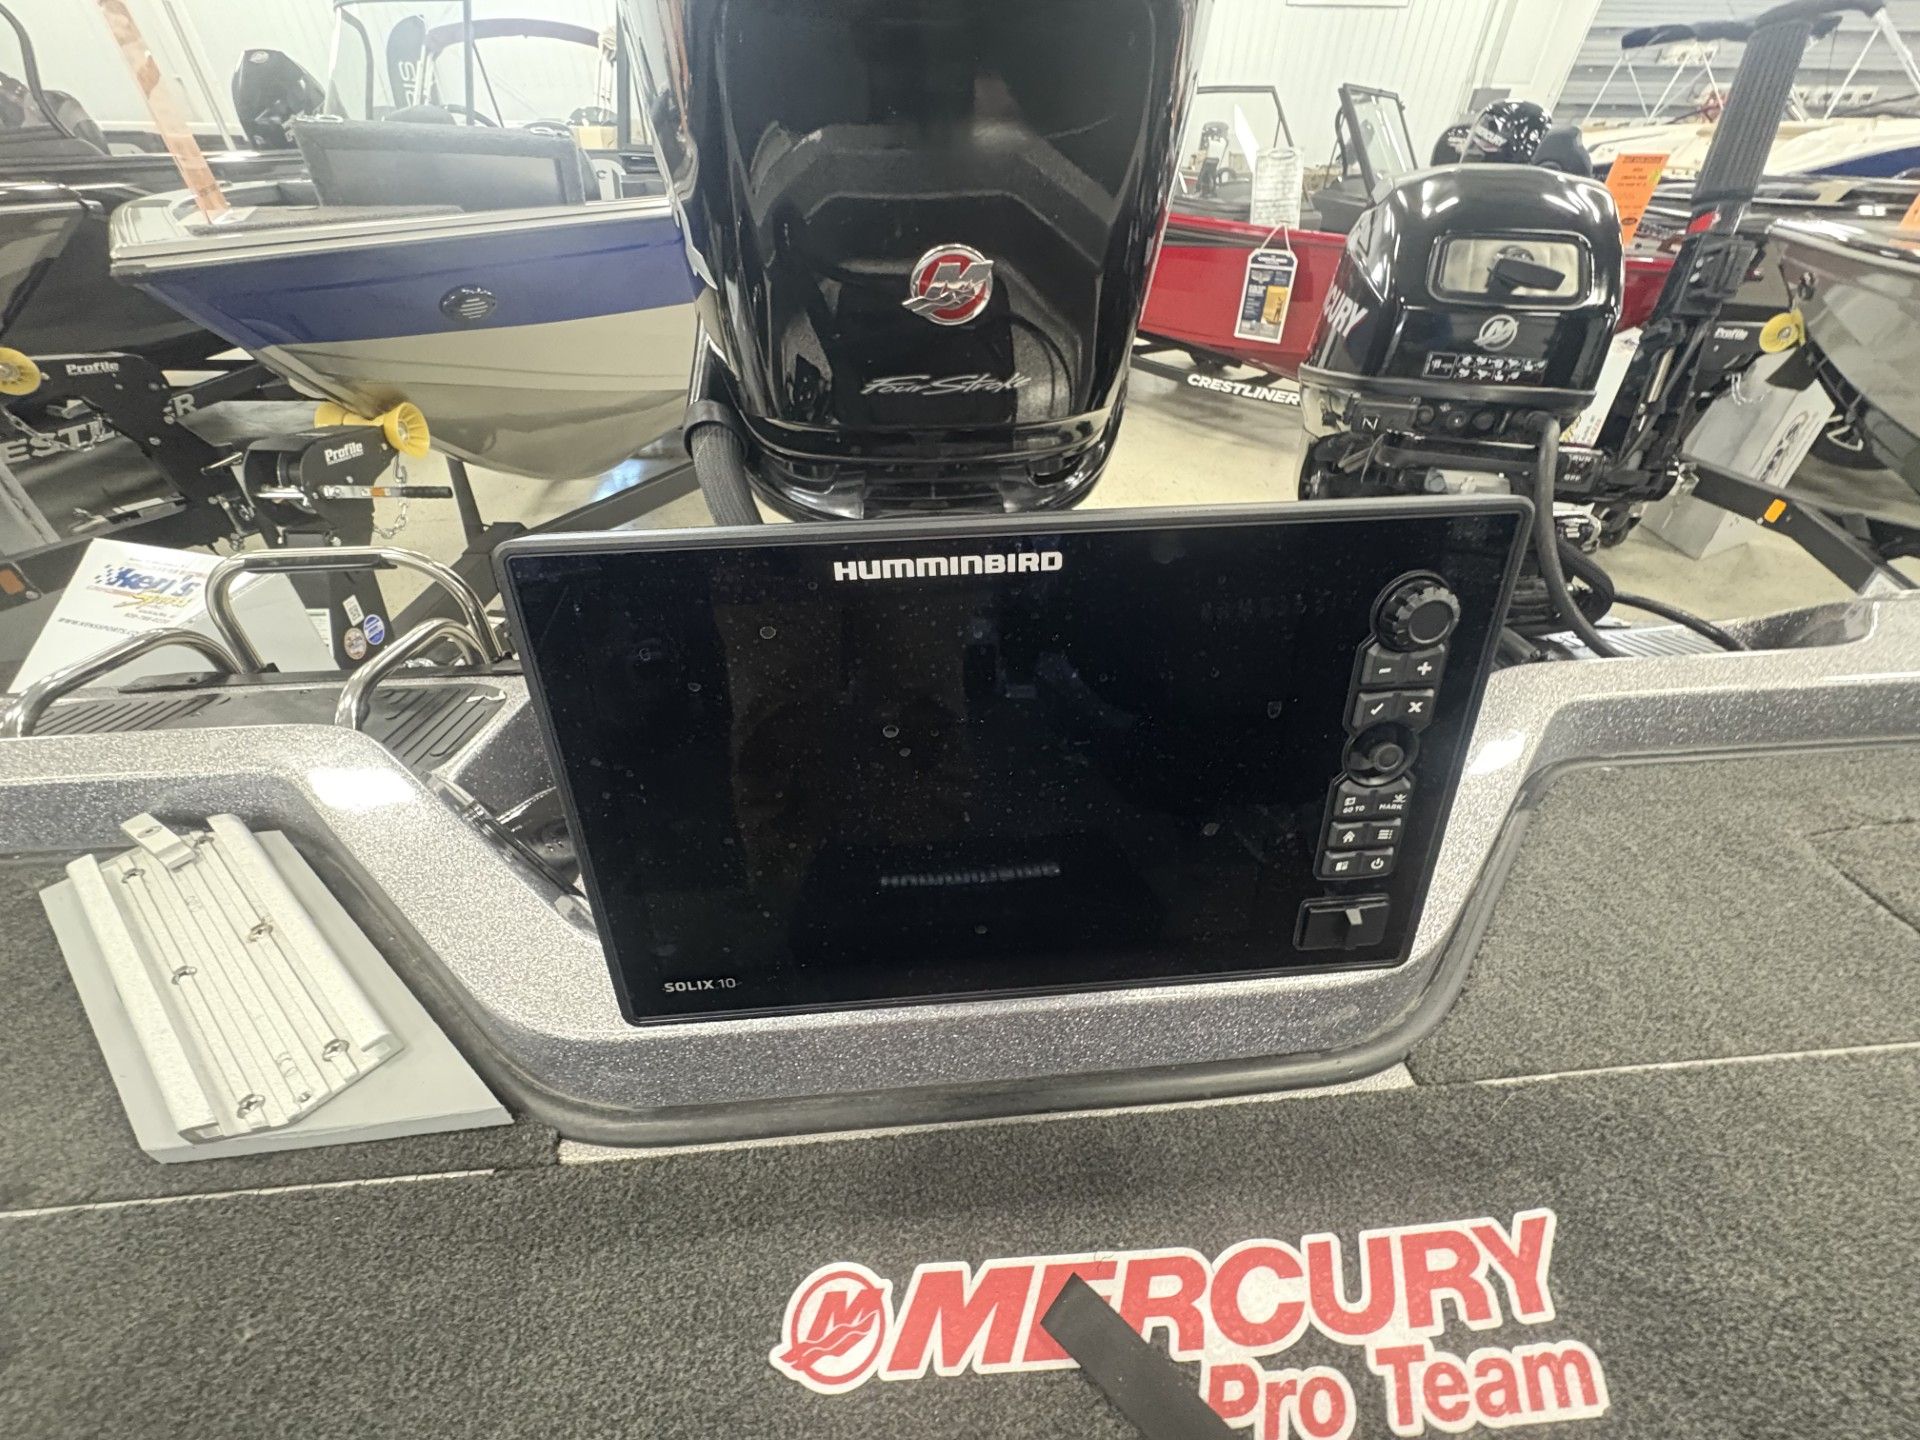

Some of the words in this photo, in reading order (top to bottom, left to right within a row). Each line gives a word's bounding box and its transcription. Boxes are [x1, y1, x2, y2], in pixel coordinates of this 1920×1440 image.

[66, 361, 120, 375] Profile
[1187, 373, 1301, 406] CRESTLINER
[324, 442, 364, 463] Profile
[1342, 806, 1354, 814] GO
[1379, 803, 1403, 811] MARK
[664, 979, 715, 993] SOLIX
[718, 977, 736, 989] 10
[1208, 1363, 1346, 1440] Pro
[1375, 1344, 1599, 1427] Team
